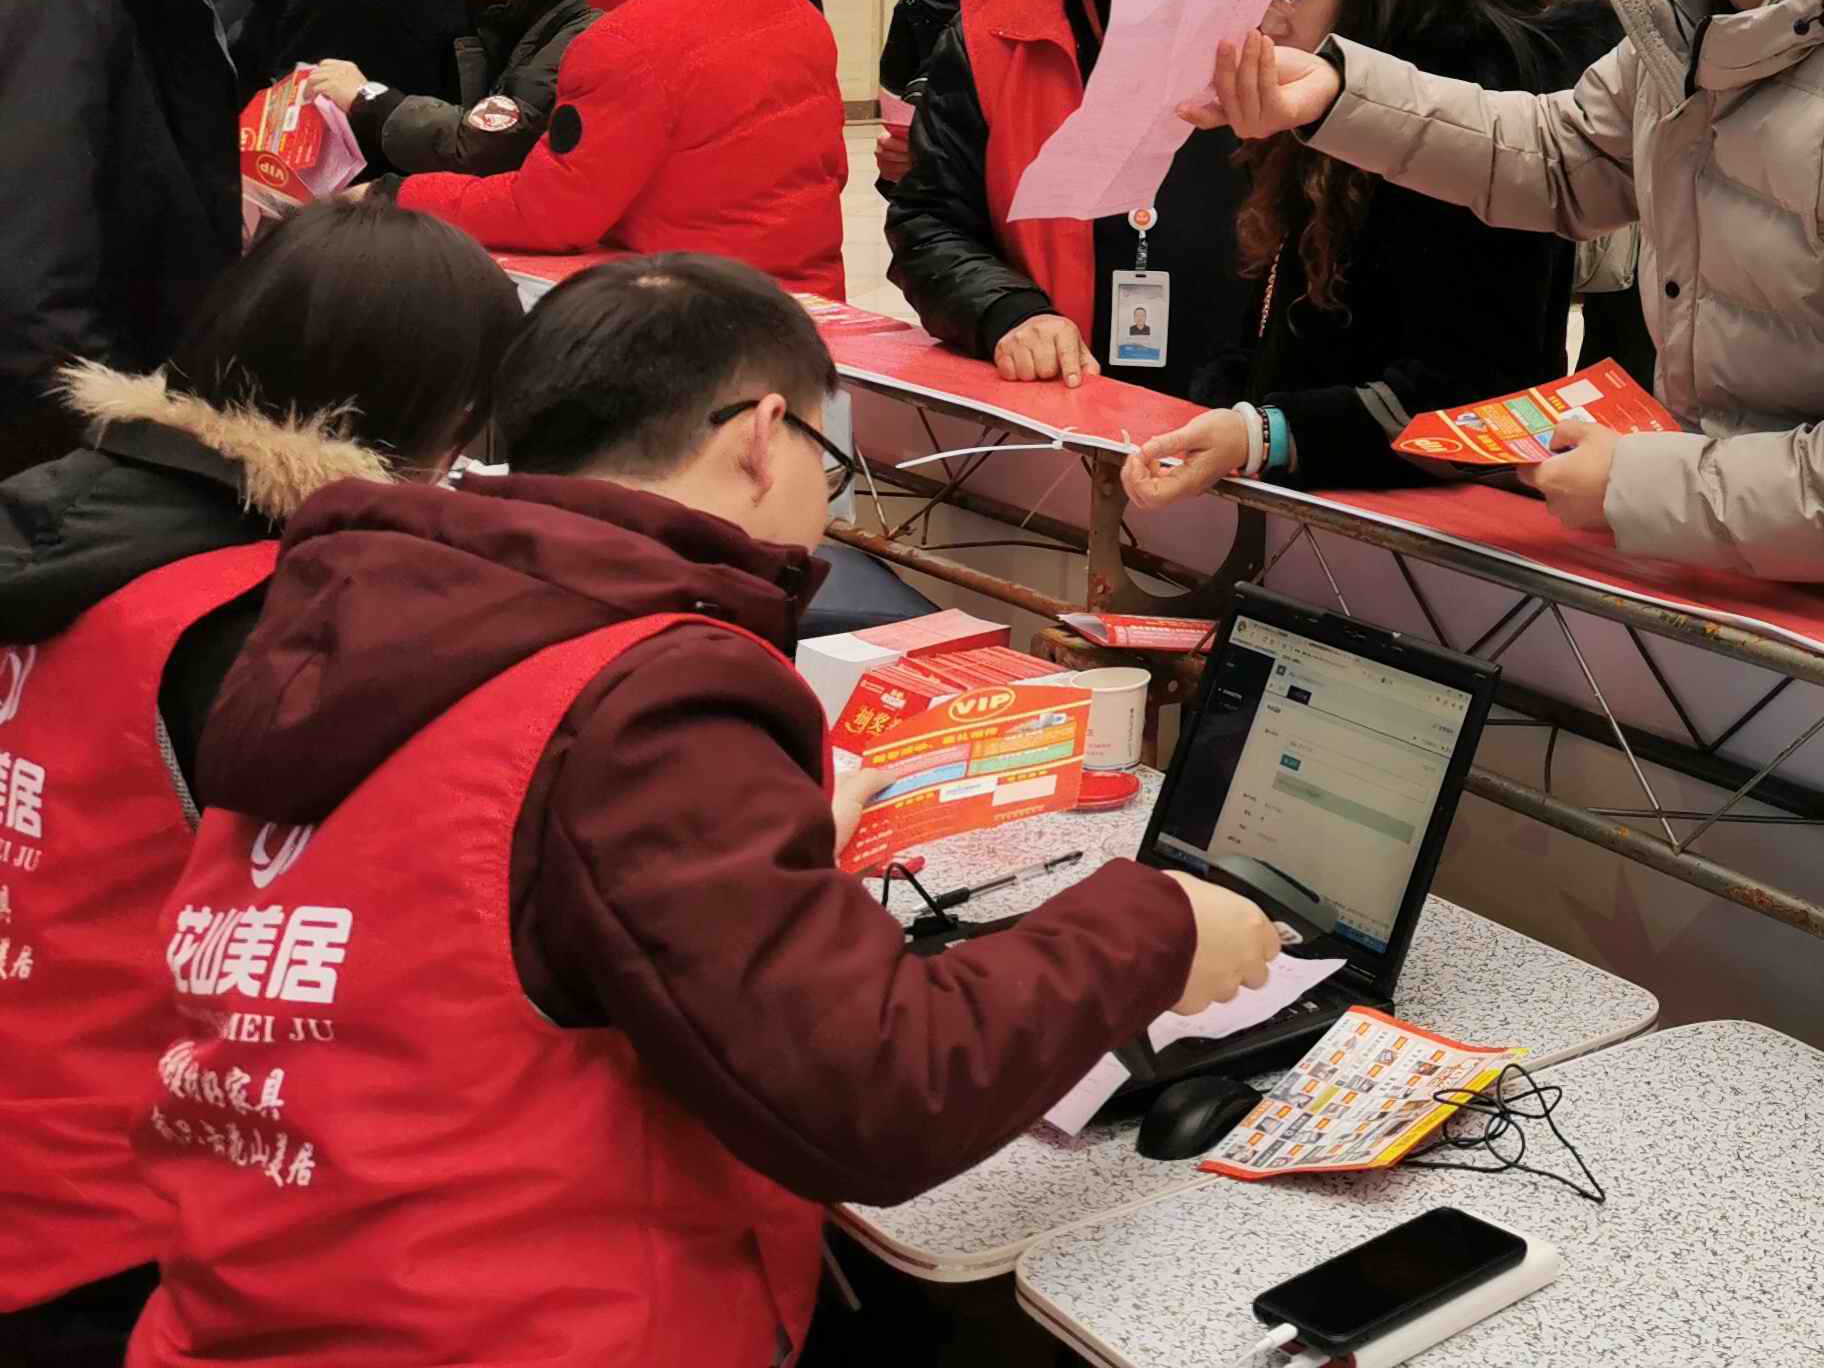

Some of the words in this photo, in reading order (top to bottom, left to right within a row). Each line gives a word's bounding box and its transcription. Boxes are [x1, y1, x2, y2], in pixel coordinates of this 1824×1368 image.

[955, 692, 1011, 715] VIP
[165, 904, 354, 1004] 花山美居
[289, 1016, 335, 1043] JU
